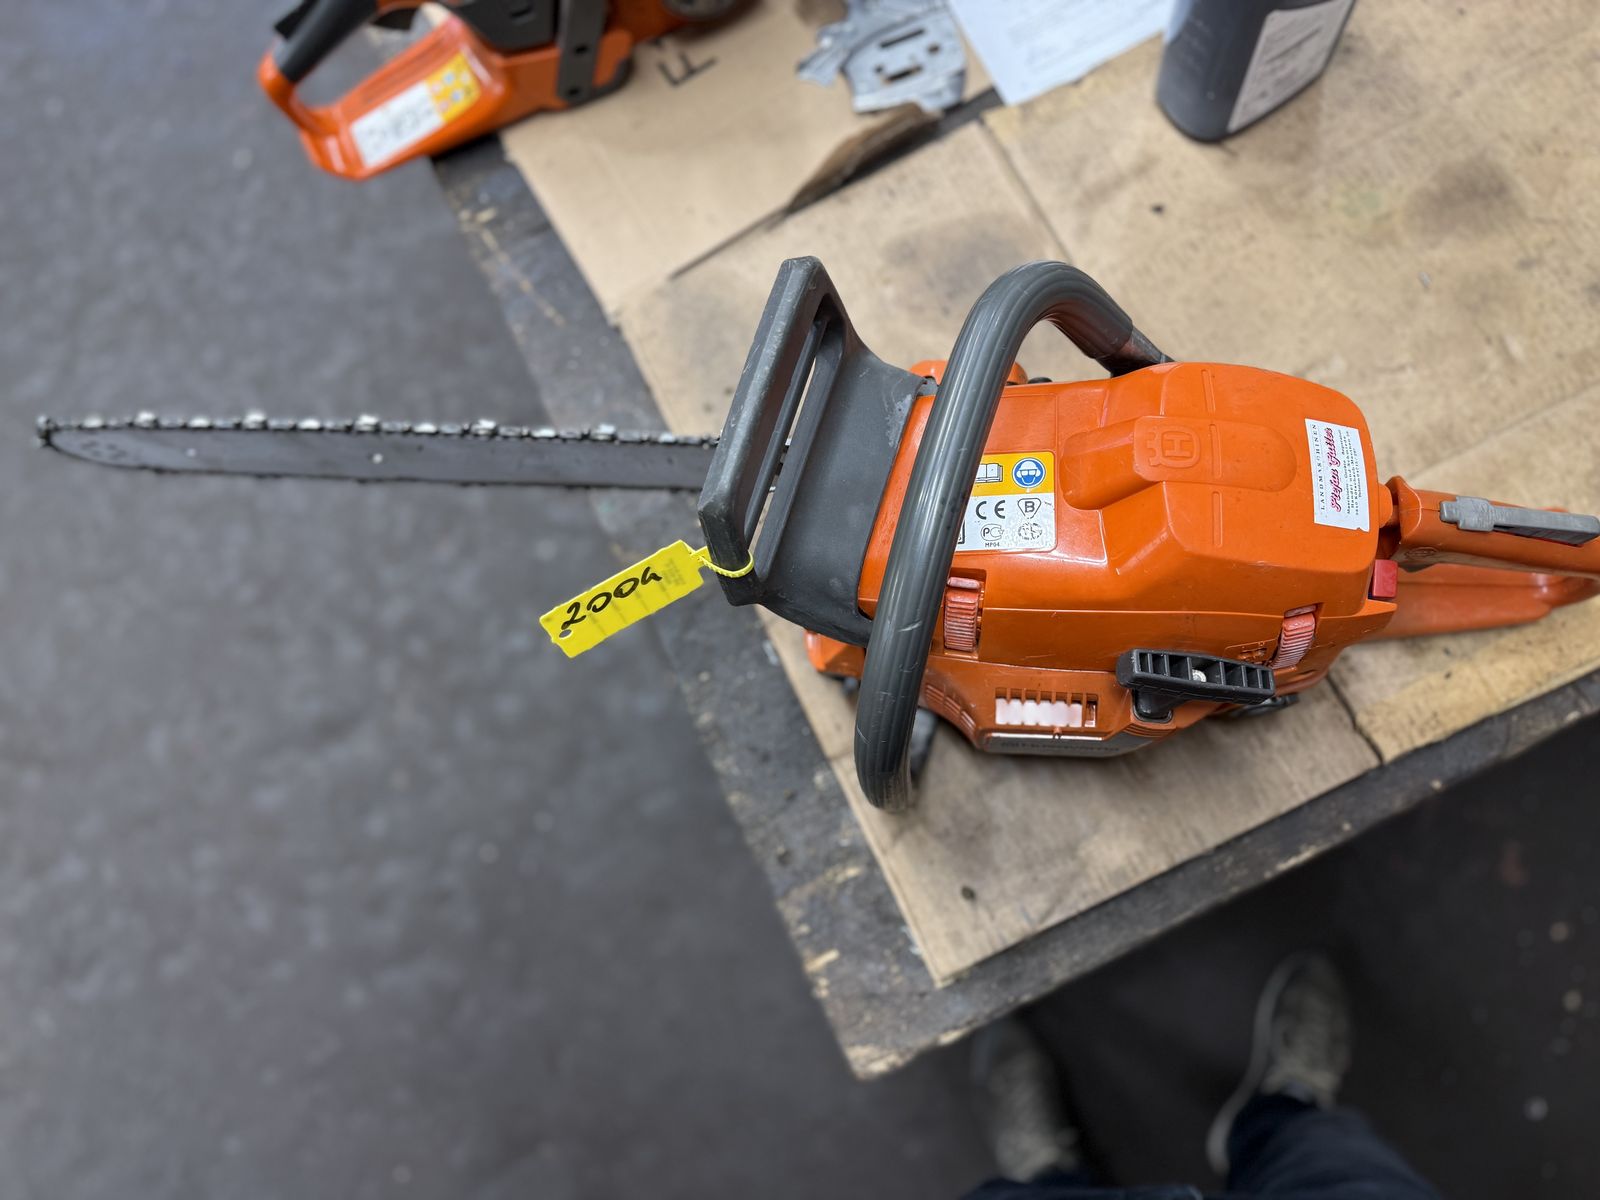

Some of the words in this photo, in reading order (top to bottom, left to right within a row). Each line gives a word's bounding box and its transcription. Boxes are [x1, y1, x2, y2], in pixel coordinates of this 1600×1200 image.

[1312, 424, 1325, 510] LANDMASCHINEN
[976, 500, 1005, 520] CE
[1024, 501, 1035, 512] B
[1330, 468, 1342, 512] Stefan
[561, 566, 662, 630] 2004
